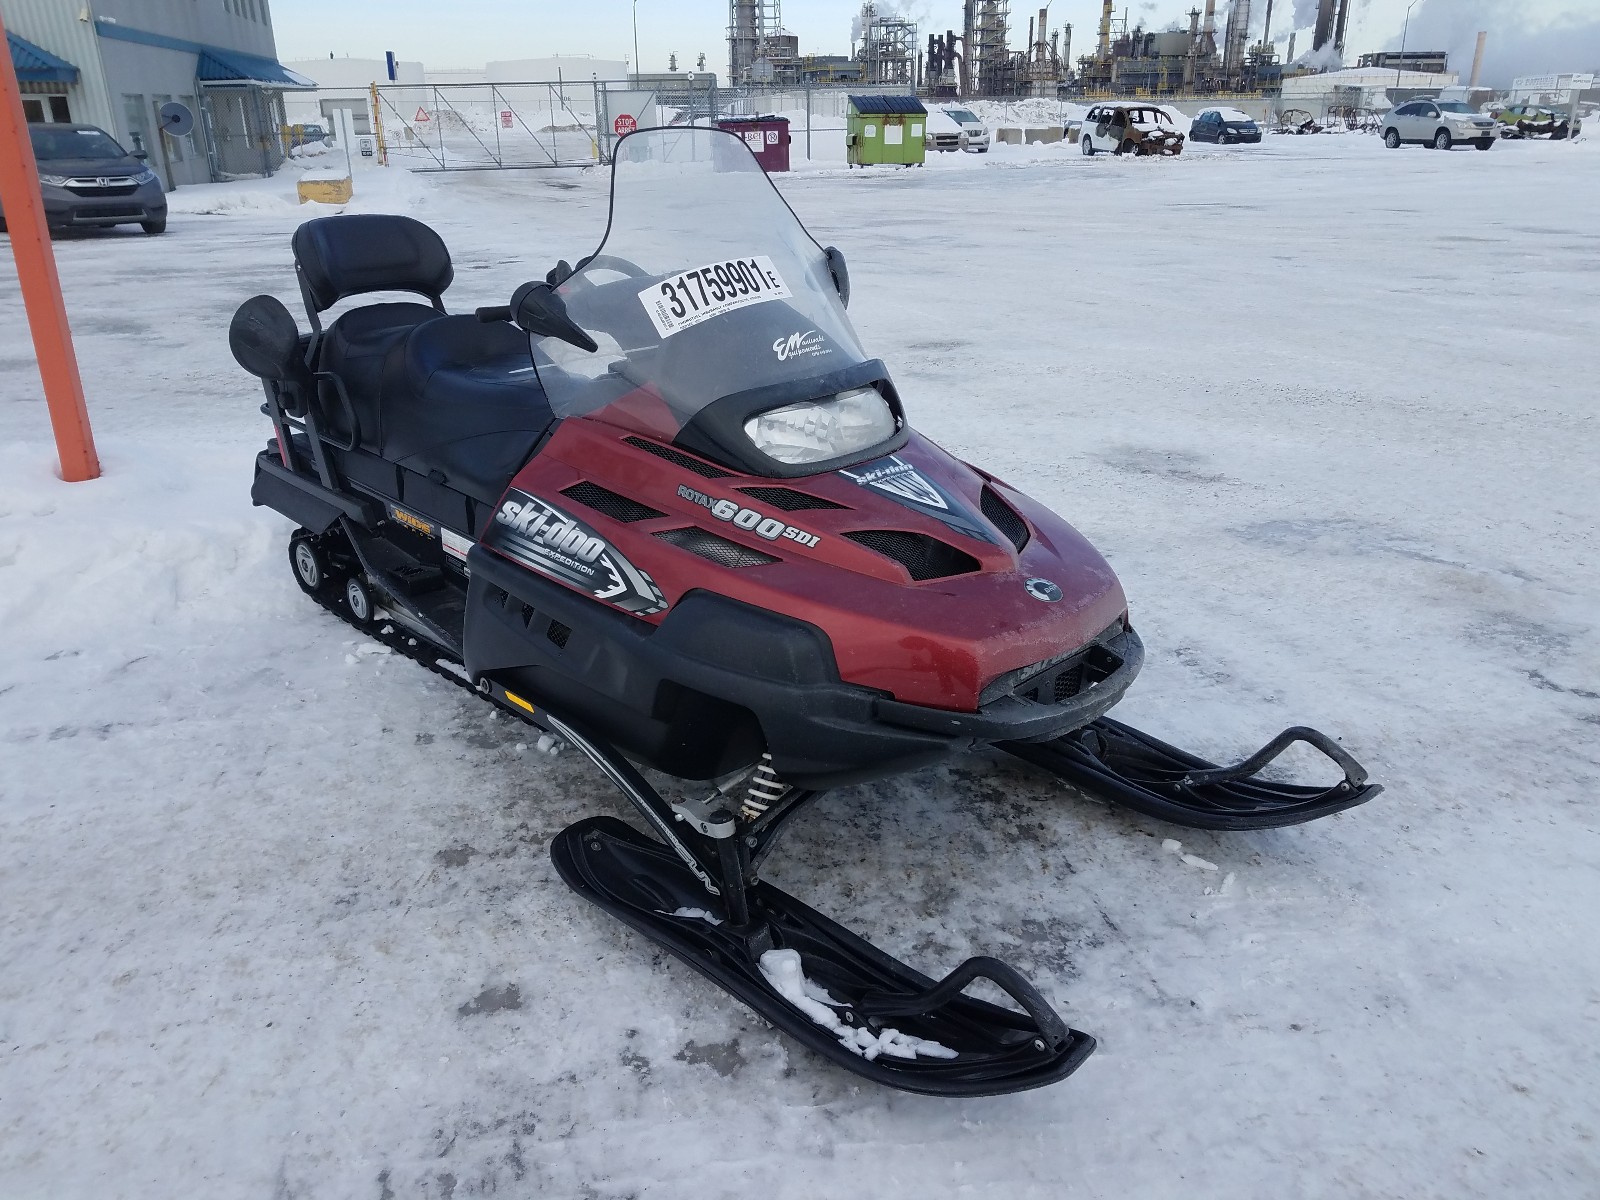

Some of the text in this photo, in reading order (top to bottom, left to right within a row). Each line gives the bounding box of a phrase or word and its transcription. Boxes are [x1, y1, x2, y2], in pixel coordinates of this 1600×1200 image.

[660, 258, 772, 319] 31759901
[766, 270, 781, 288] E
[495, 499, 606, 563] ski-doo
[677, 484, 821, 548] ROTAX 600 SDI
[544, 548, 595, 576] EXPEDITION
